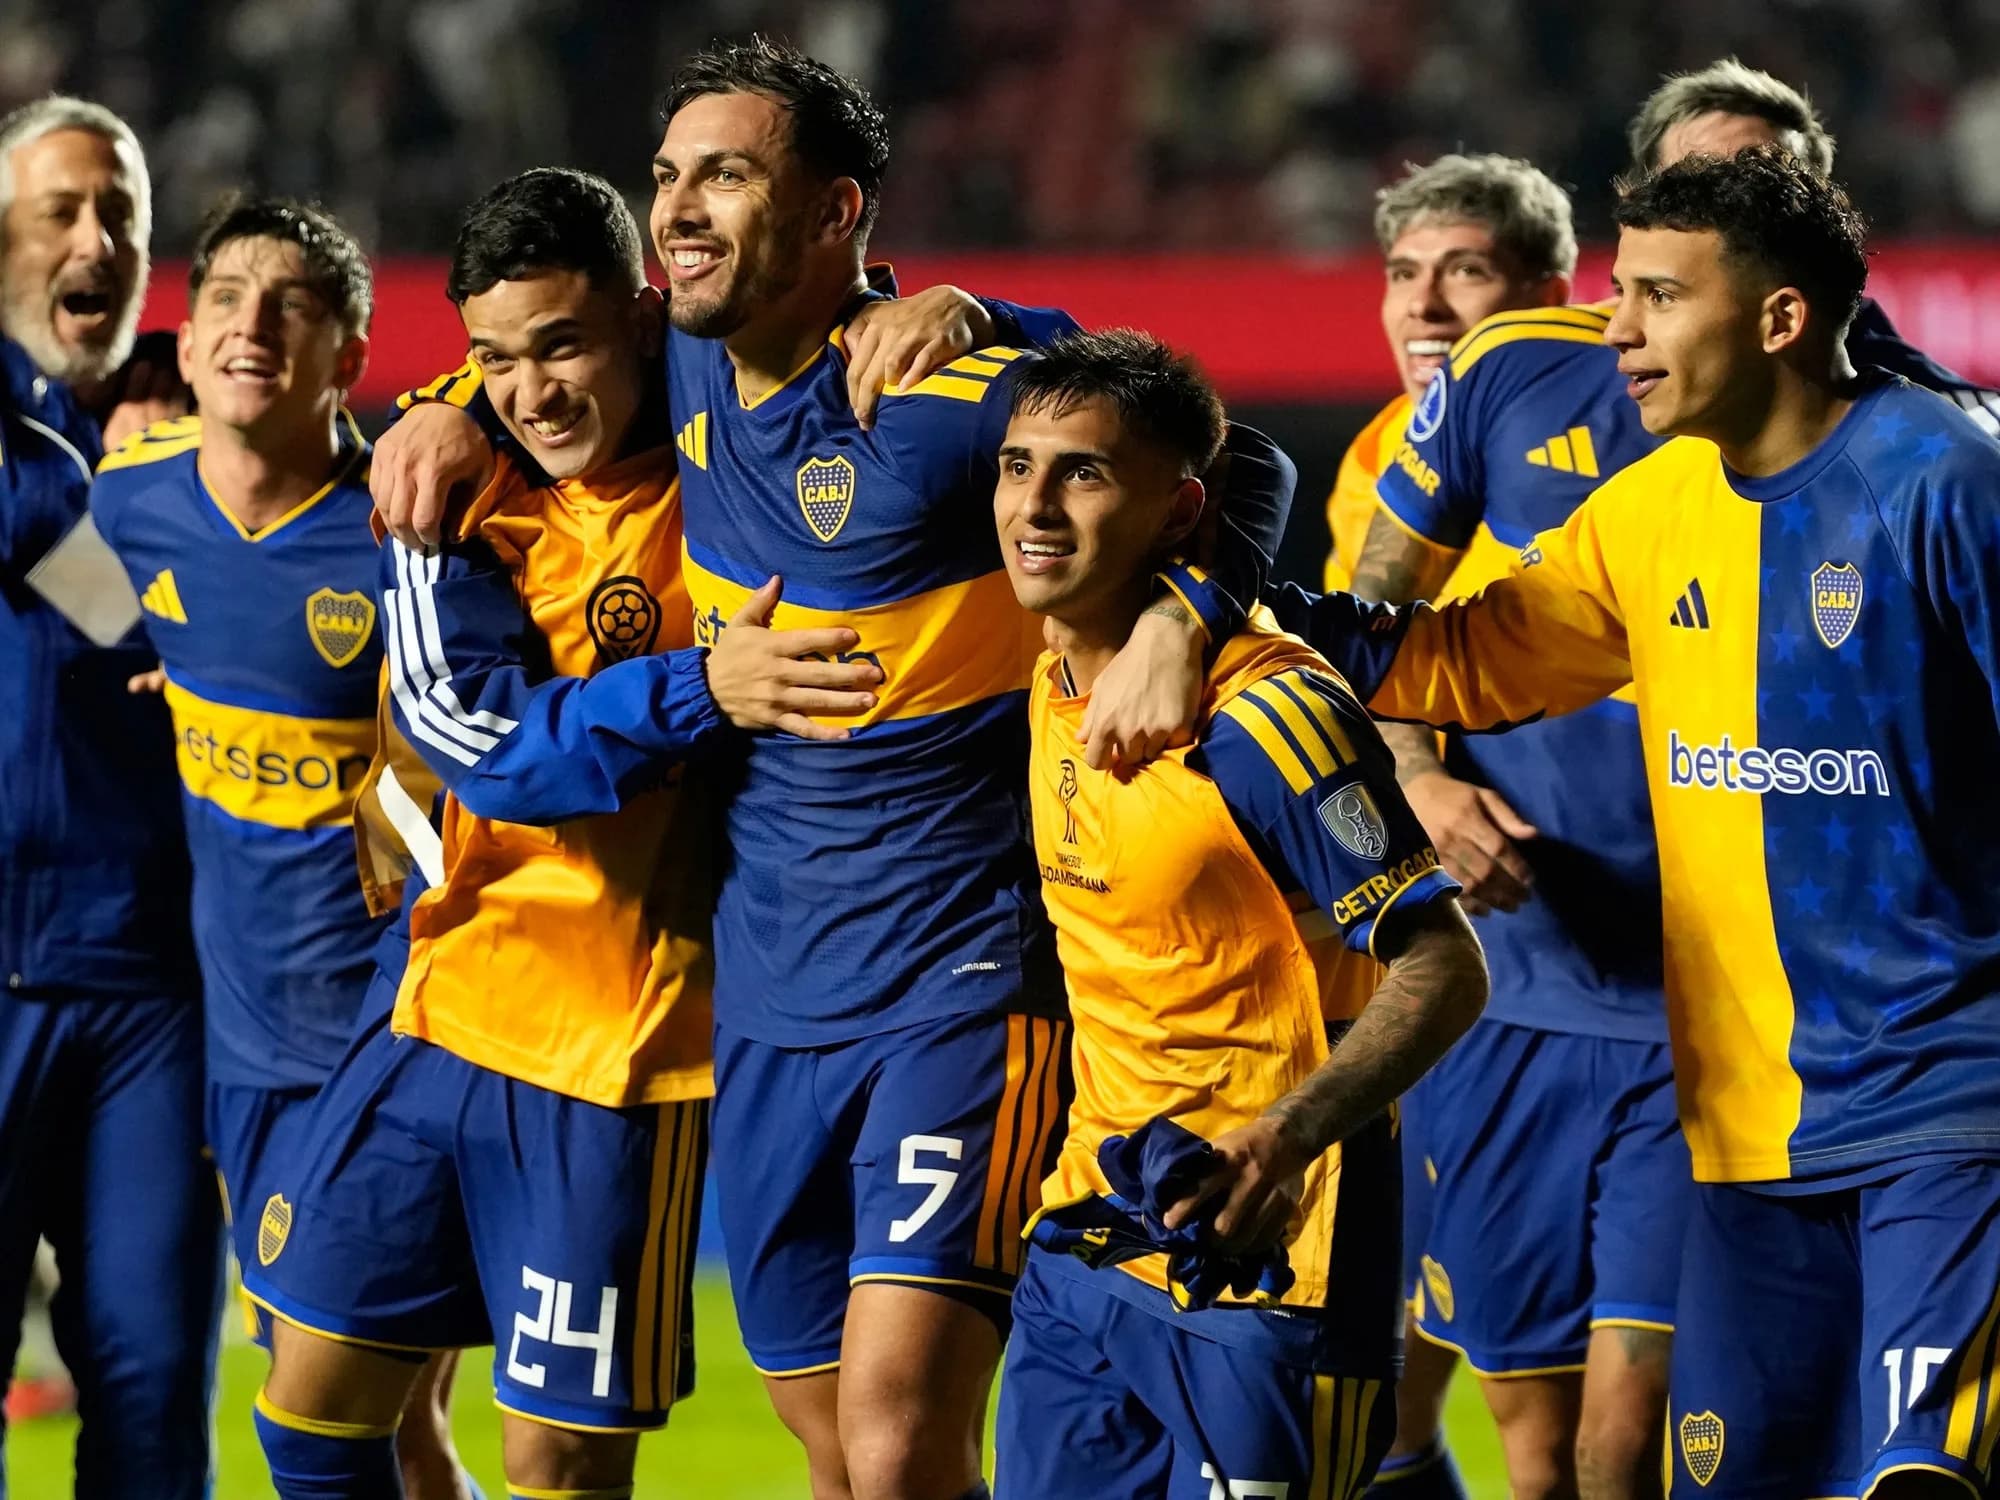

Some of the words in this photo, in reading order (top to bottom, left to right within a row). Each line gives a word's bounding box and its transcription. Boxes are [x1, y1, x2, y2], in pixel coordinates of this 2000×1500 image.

[805, 484, 848, 504] CABJ
[1818, 591, 1856, 609] CABJ
[184, 726, 371, 791] etsson
[1670, 730, 1890, 796] betsson
[1363, 836, 1381, 855] 2
[1040, 864, 1112, 893] UDAMERICANA
[1332, 847, 1437, 925] CETROGAR
[888, 1134, 963, 1242] 5
[507, 1265, 618, 1397] 24
[1686, 1435, 1718, 1453] CABJ
